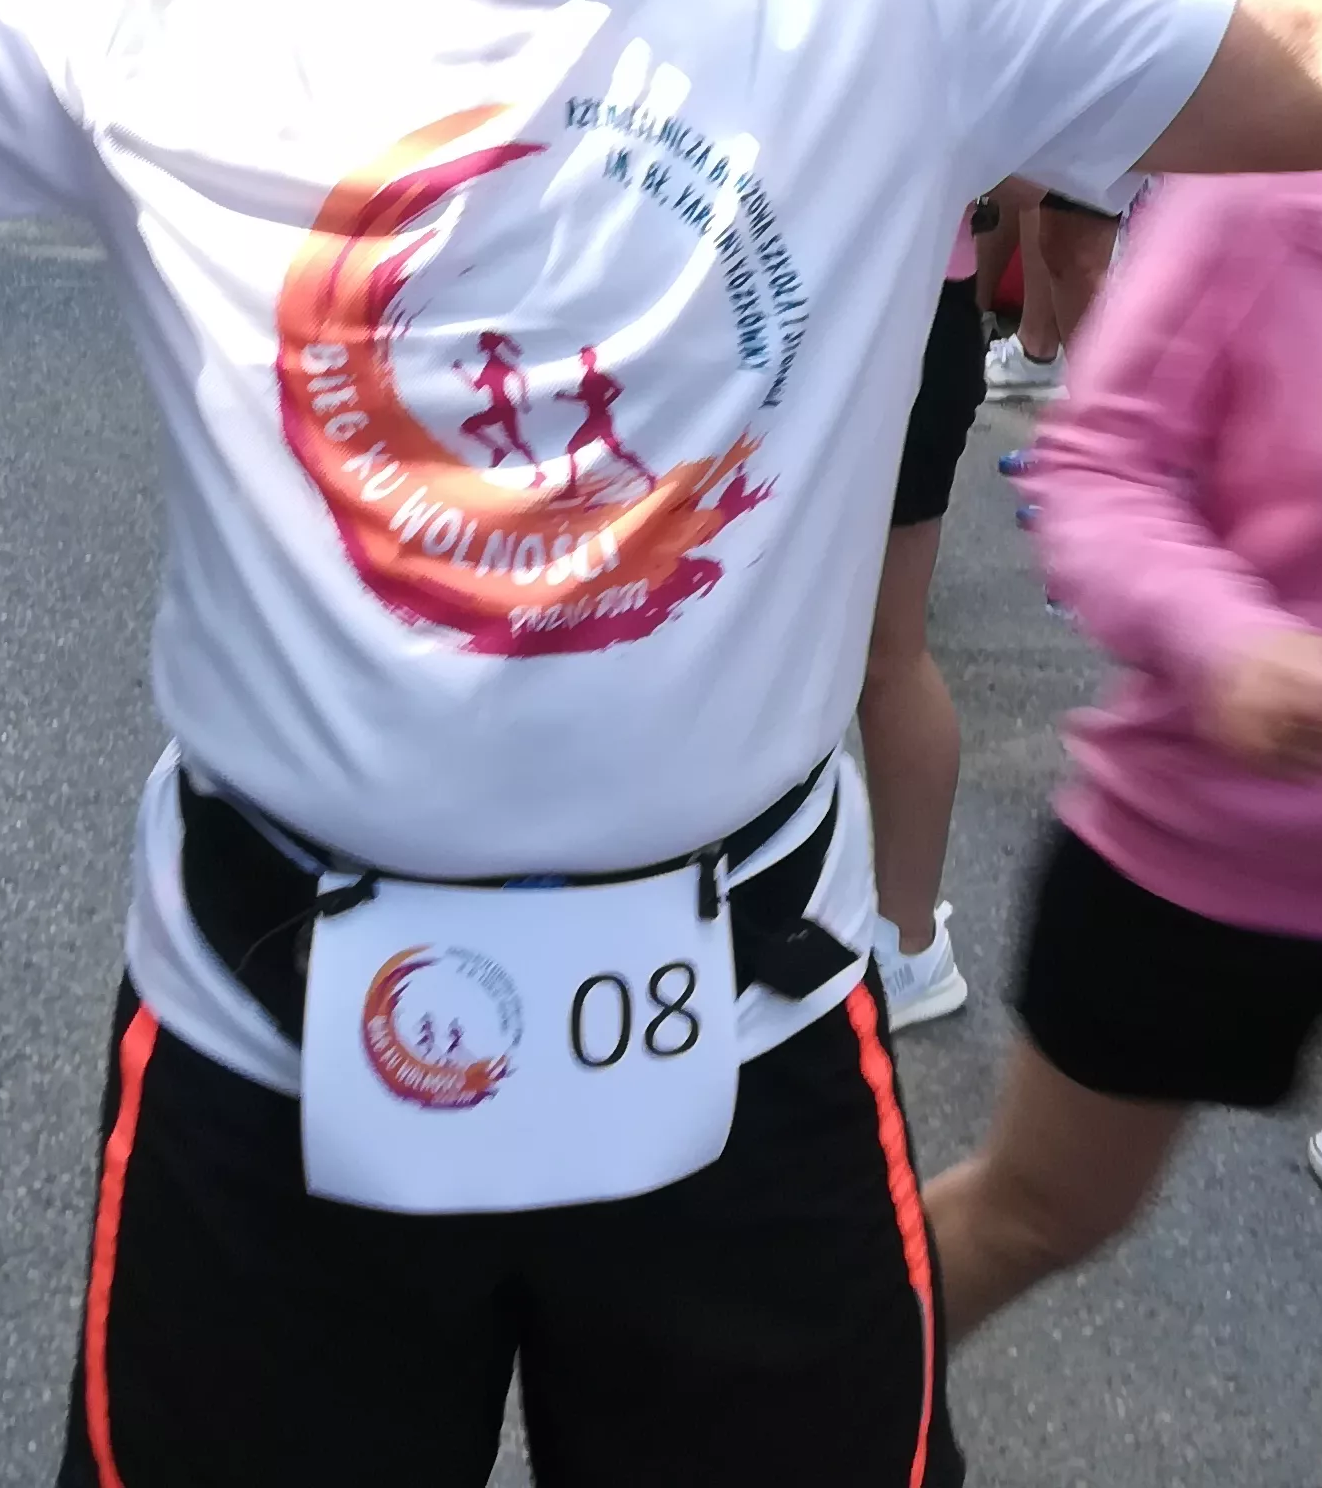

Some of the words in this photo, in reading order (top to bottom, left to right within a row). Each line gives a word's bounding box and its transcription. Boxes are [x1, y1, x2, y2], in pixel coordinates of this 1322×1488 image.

[300, 343, 370, 443] BIEG
[341, 439, 410, 503] KU
[388, 485, 621, 586] WOLNOŚCI
[569, 960, 701, 1069] 08
